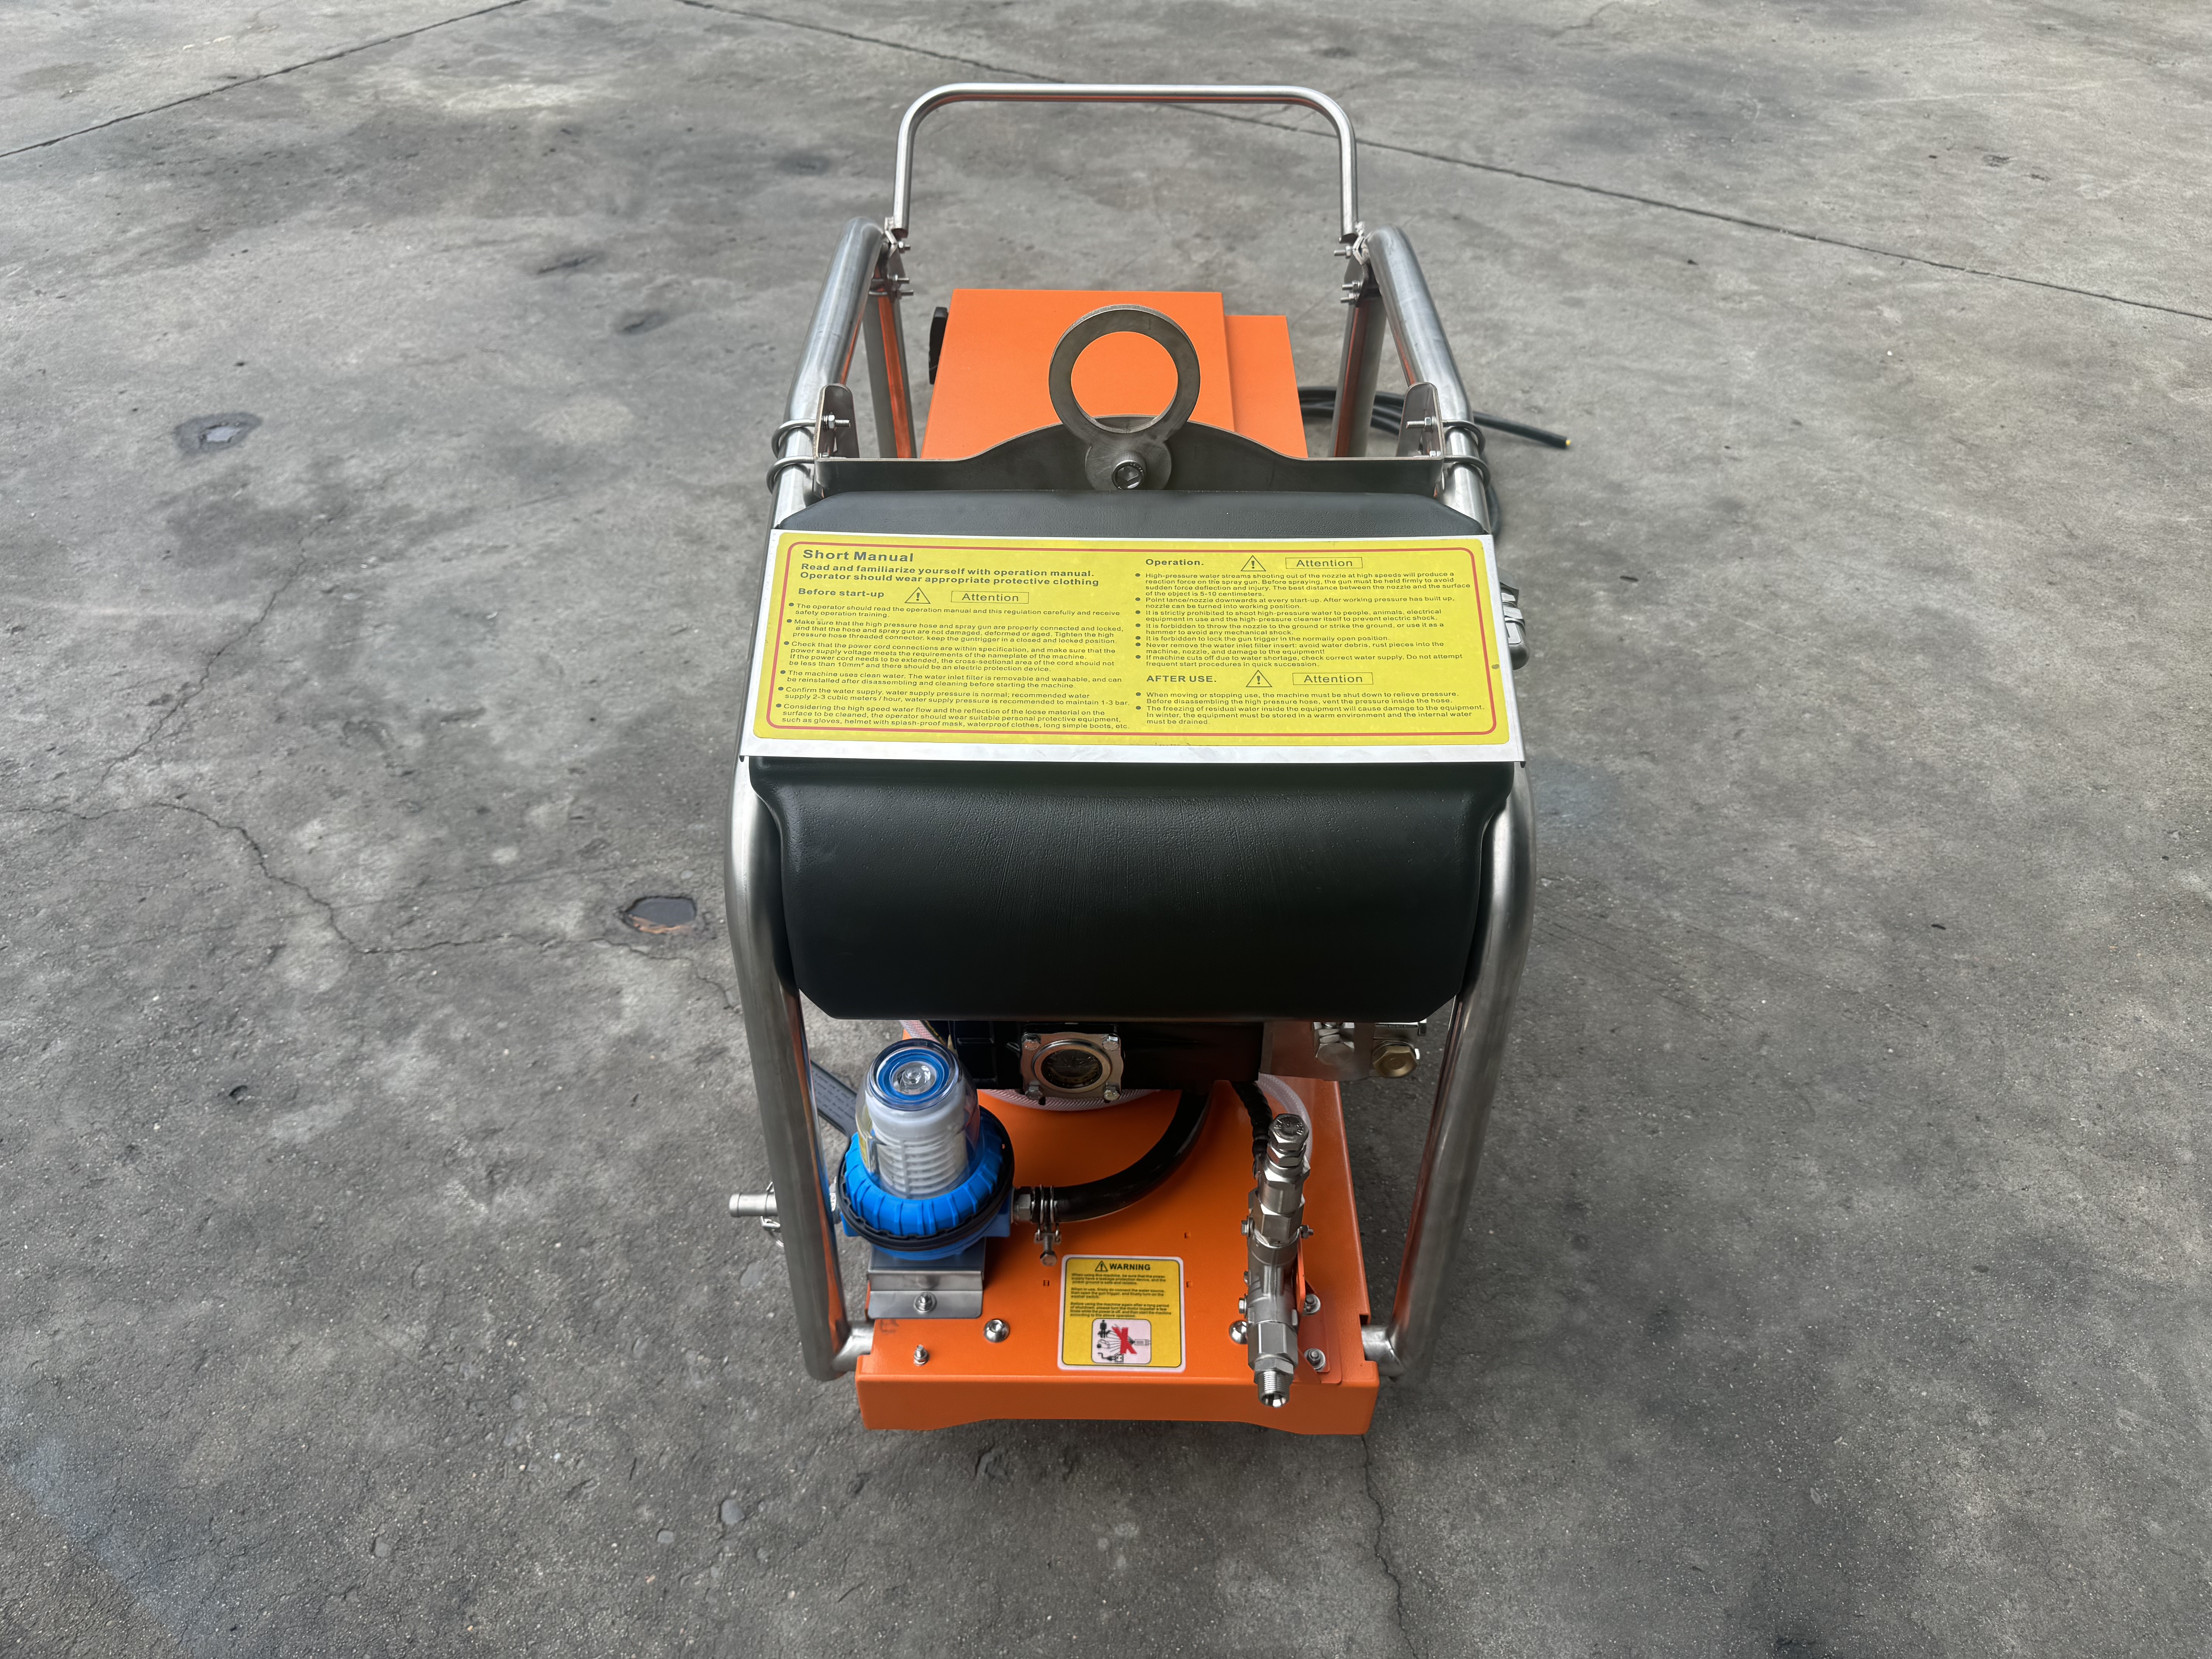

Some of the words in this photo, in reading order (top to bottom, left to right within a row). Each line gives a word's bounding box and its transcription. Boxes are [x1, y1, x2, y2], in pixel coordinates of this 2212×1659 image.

[802, 549, 849, 560] Short
[854, 551, 914, 562] Manual
[1145, 558, 1204, 567] Operation.
[1296, 559, 1353, 567] Attention
[856, 565, 915, 573] familiarize
[800, 572, 851, 580] Operator
[1053, 578, 1099, 587] clothing
[839, 590, 884, 599] start-up
[962, 593, 1019, 601] Attention
[1304, 674, 1363, 683] Attention
